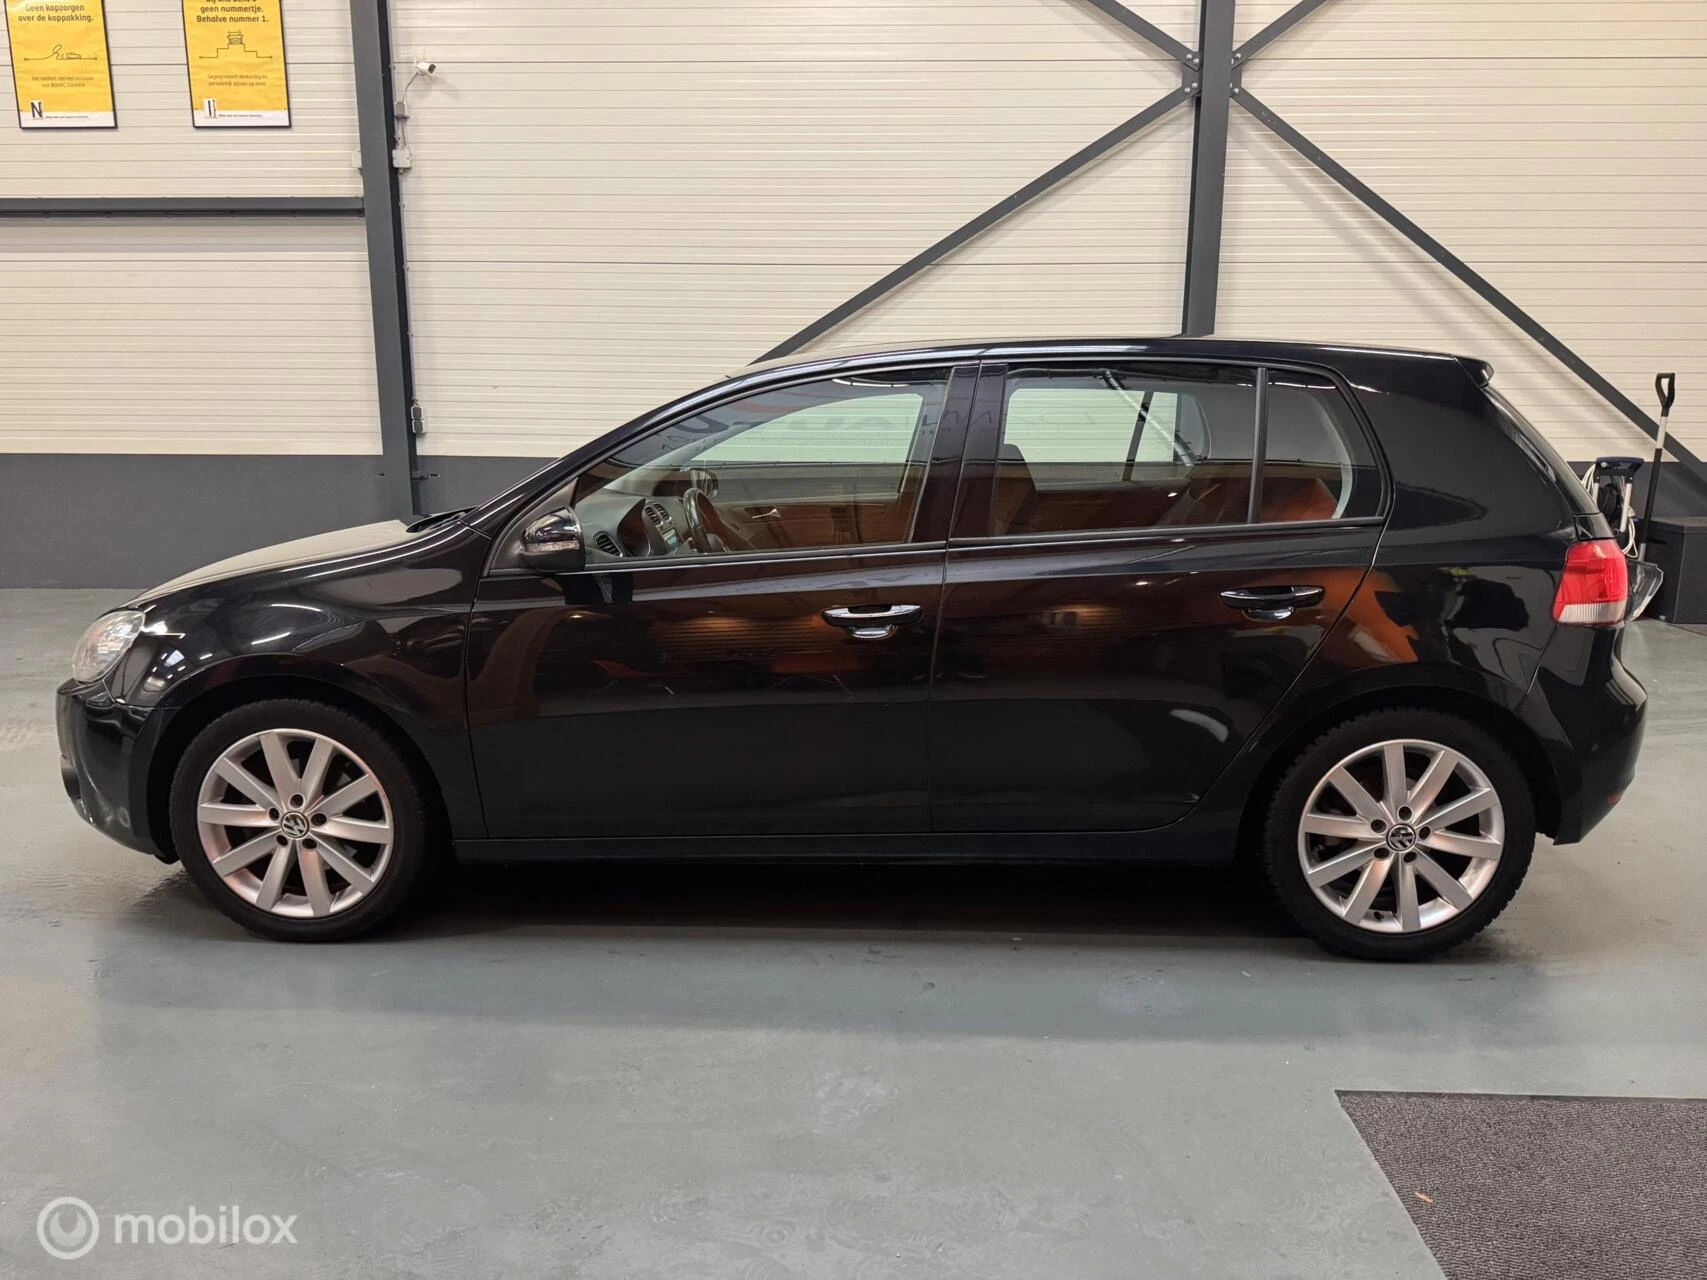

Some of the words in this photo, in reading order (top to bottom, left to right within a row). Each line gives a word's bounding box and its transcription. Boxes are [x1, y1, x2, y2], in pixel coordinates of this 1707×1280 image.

[24, 3, 44, 12] Geen
[45, 4, 85, 12] kopzorgen
[200, 6, 219, 14] geen
[220, 5, 264, 14] nummertje.
[47, 14, 94, 22] koppakking.
[196, 15, 227, 23] Behalve
